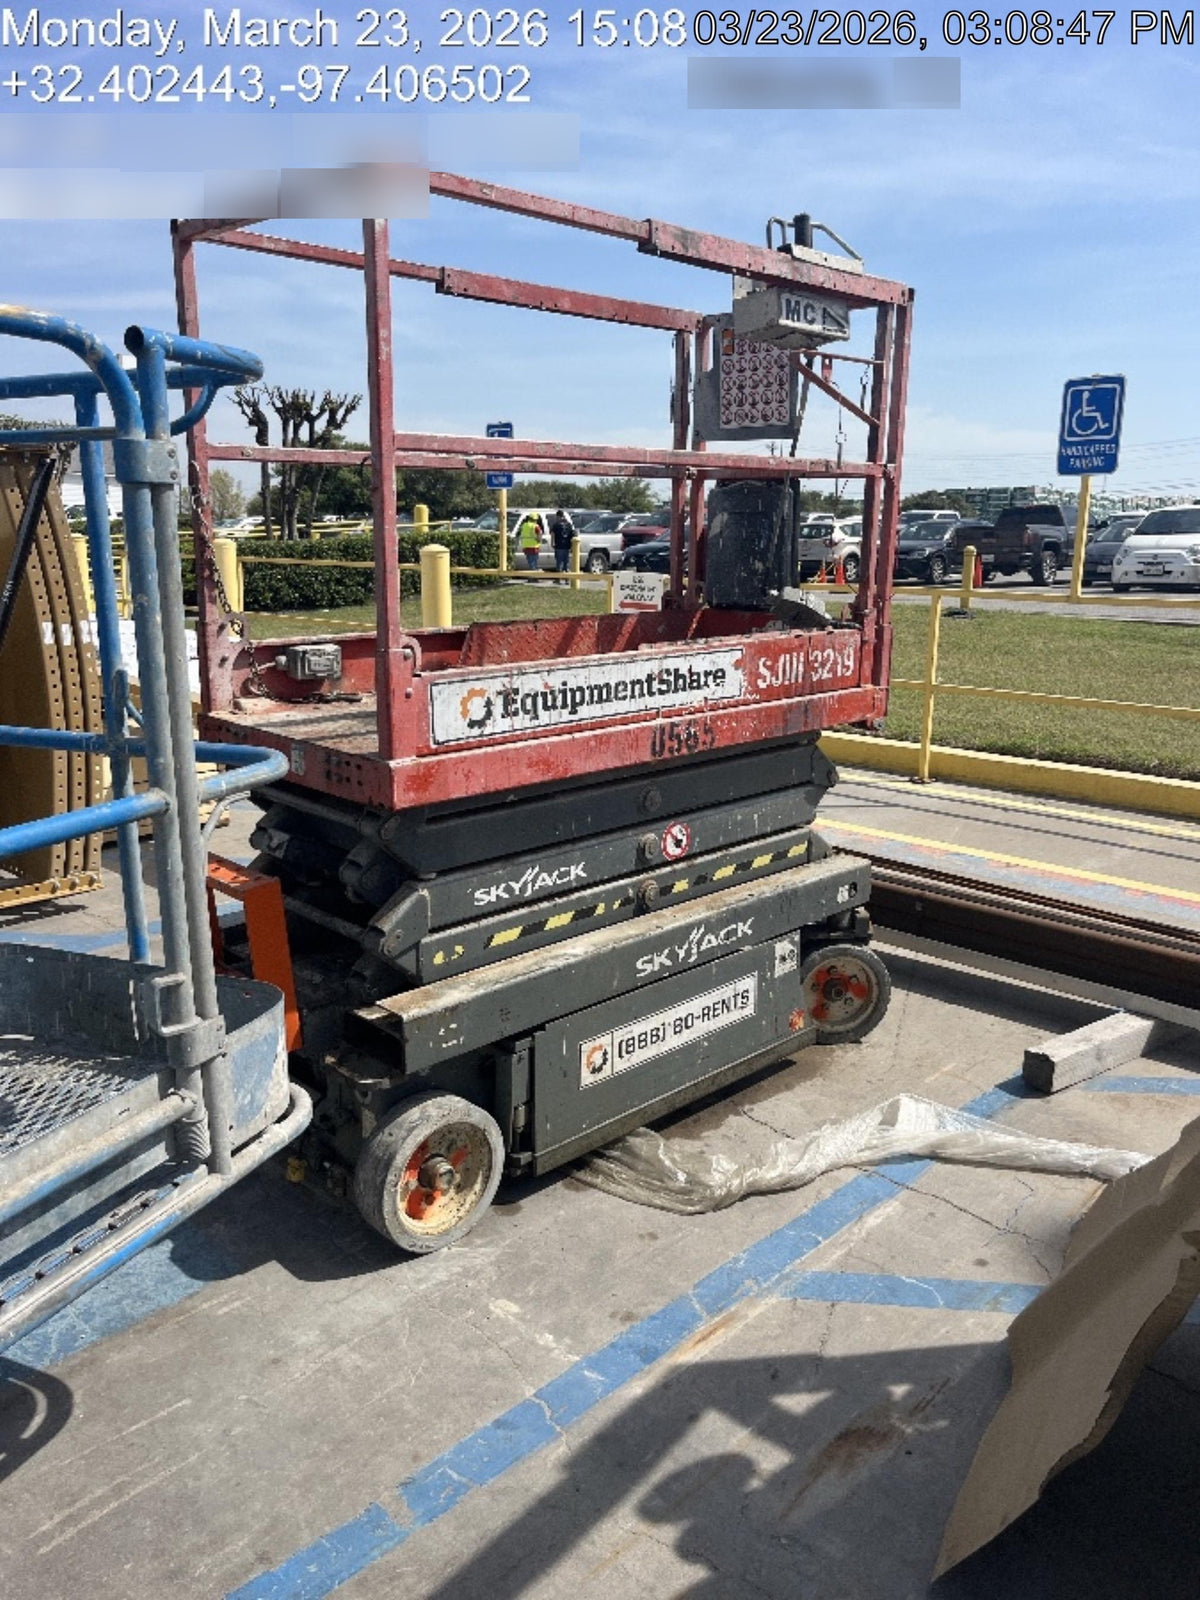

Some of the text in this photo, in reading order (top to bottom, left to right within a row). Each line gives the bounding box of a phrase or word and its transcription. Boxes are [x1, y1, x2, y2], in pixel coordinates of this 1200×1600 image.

[498, 665, 727, 721] EquipmentShare
[474, 861, 588, 906] SKYJACK
[635, 916, 755, 977] SKYJACK
